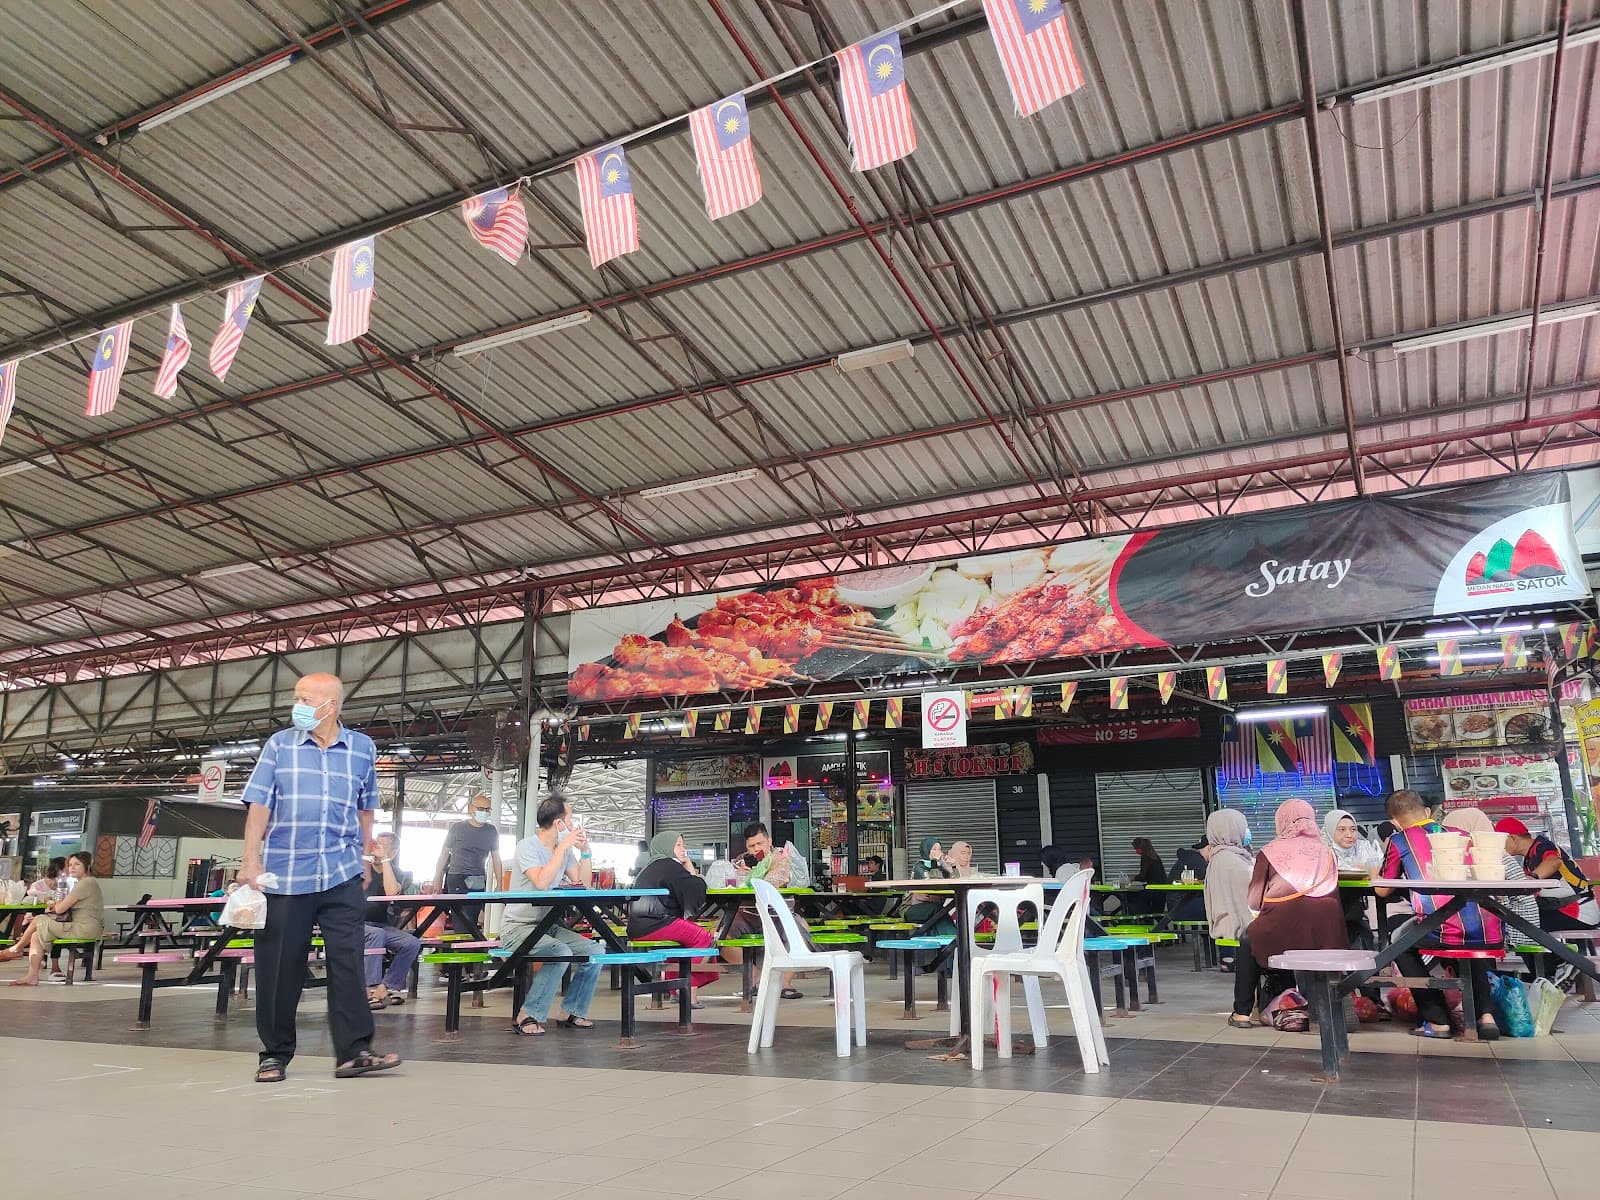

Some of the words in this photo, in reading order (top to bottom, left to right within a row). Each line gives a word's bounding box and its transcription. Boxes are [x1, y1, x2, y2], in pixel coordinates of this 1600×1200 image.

[1245, 558, 1352, 597] Satay
[1516, 575, 1568, 591] SATOK
[1095, 730, 1114, 741] NO
[1118, 728, 1138, 740] 35
[947, 755, 1025, 774] CORNER
